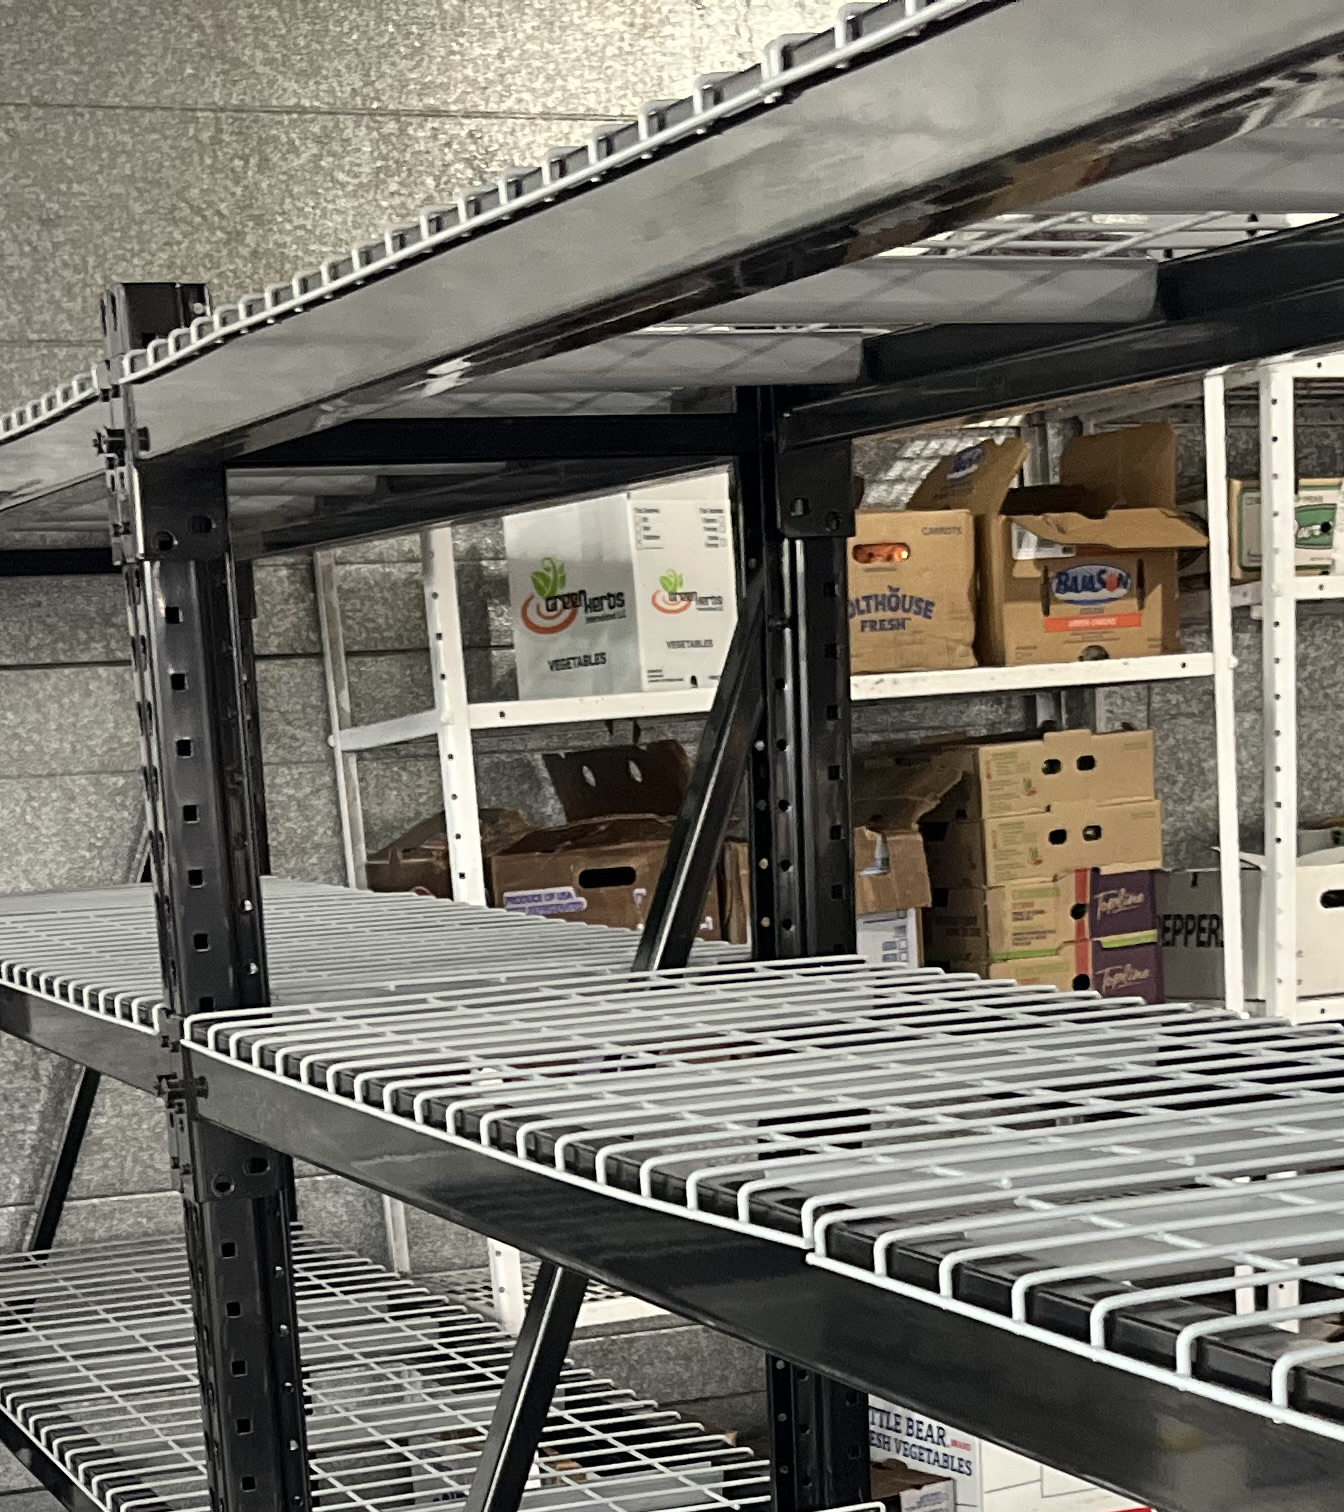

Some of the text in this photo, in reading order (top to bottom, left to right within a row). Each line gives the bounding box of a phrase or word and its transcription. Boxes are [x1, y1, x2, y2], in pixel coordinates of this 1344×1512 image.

[848, 593, 935, 620] OLTHOUSE
[861, 618, 907, 632] FRESH
[547, 652, 607, 671] VEGETABLES
[1156, 913, 1224, 948] EPPER
[868, 1406, 947, 1448] TTLE BEAR
[868, 1429, 973, 1477] ESH VEGETABLES
